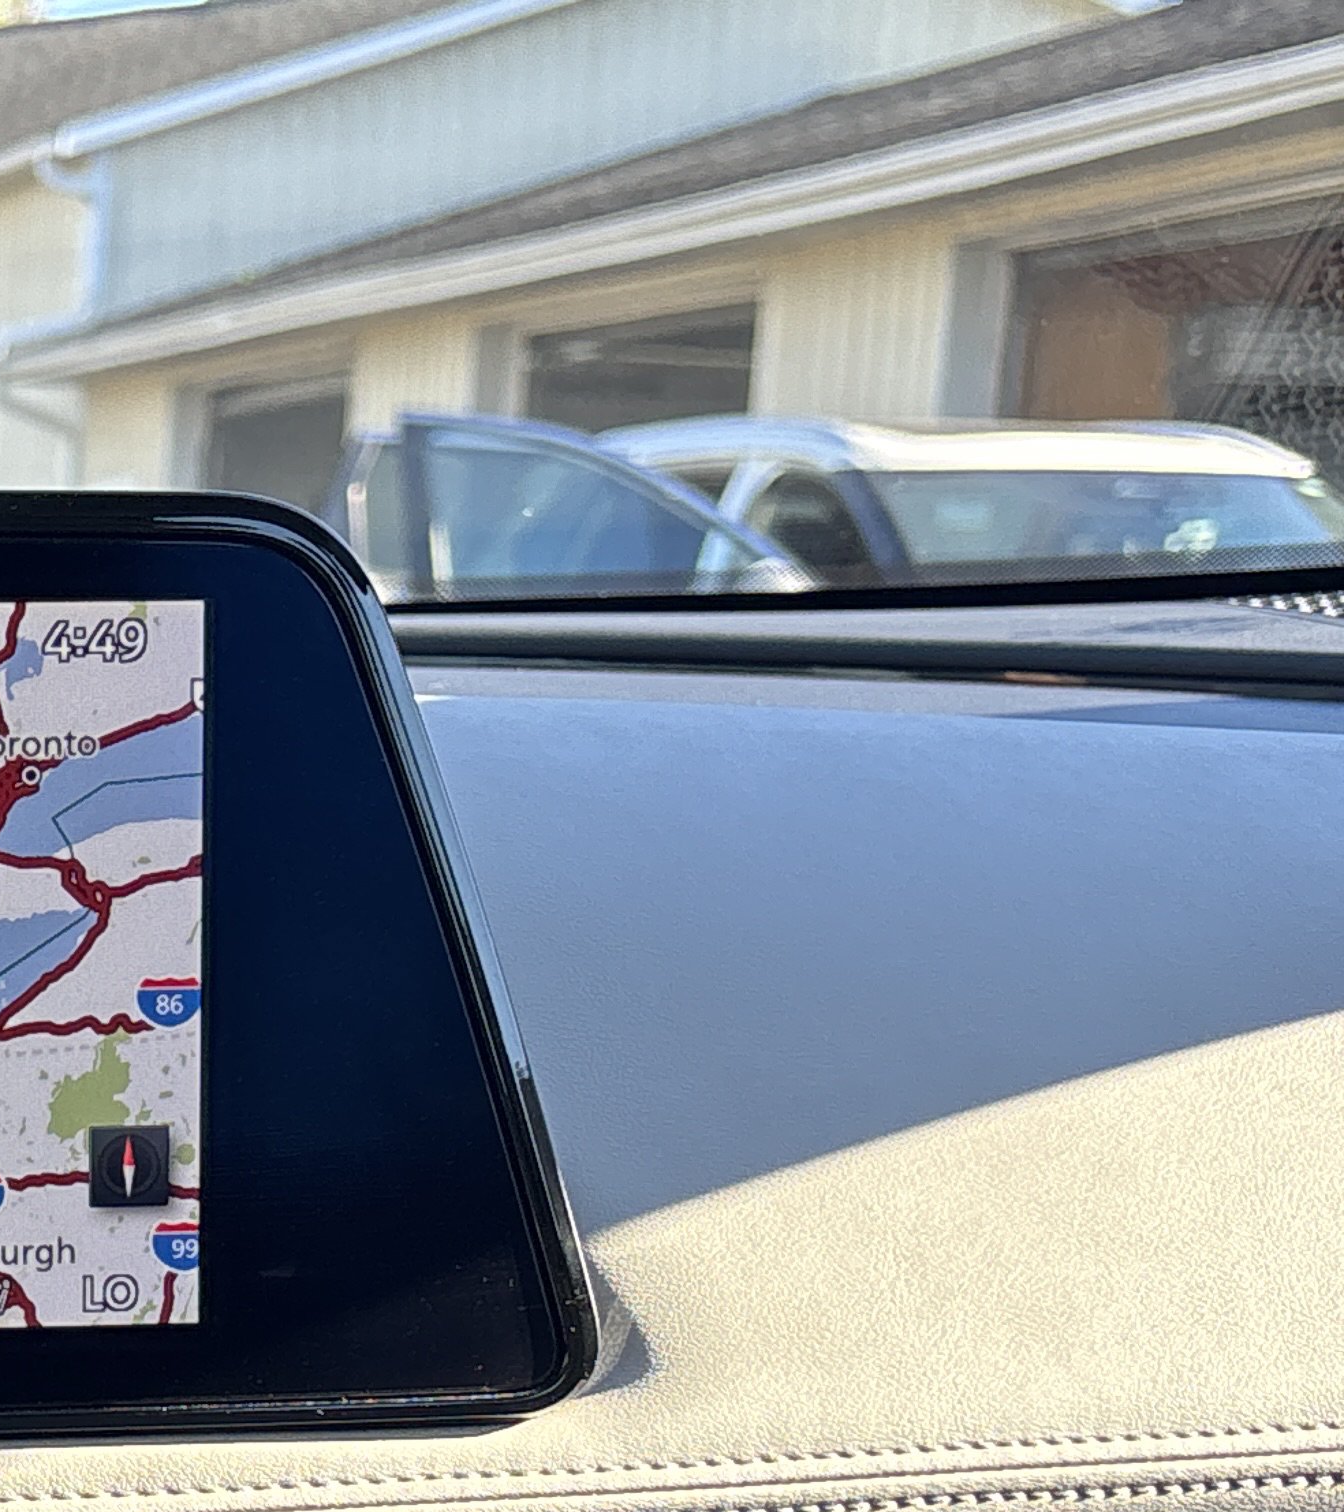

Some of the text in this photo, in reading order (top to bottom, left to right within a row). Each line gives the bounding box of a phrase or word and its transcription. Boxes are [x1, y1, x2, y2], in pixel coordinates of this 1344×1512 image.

[42, 618, 148, 663] 4:49
[155, 994, 184, 1015] 86
[172, 1238, 199, 1259] 99
[82, 1273, 140, 1313] LO
